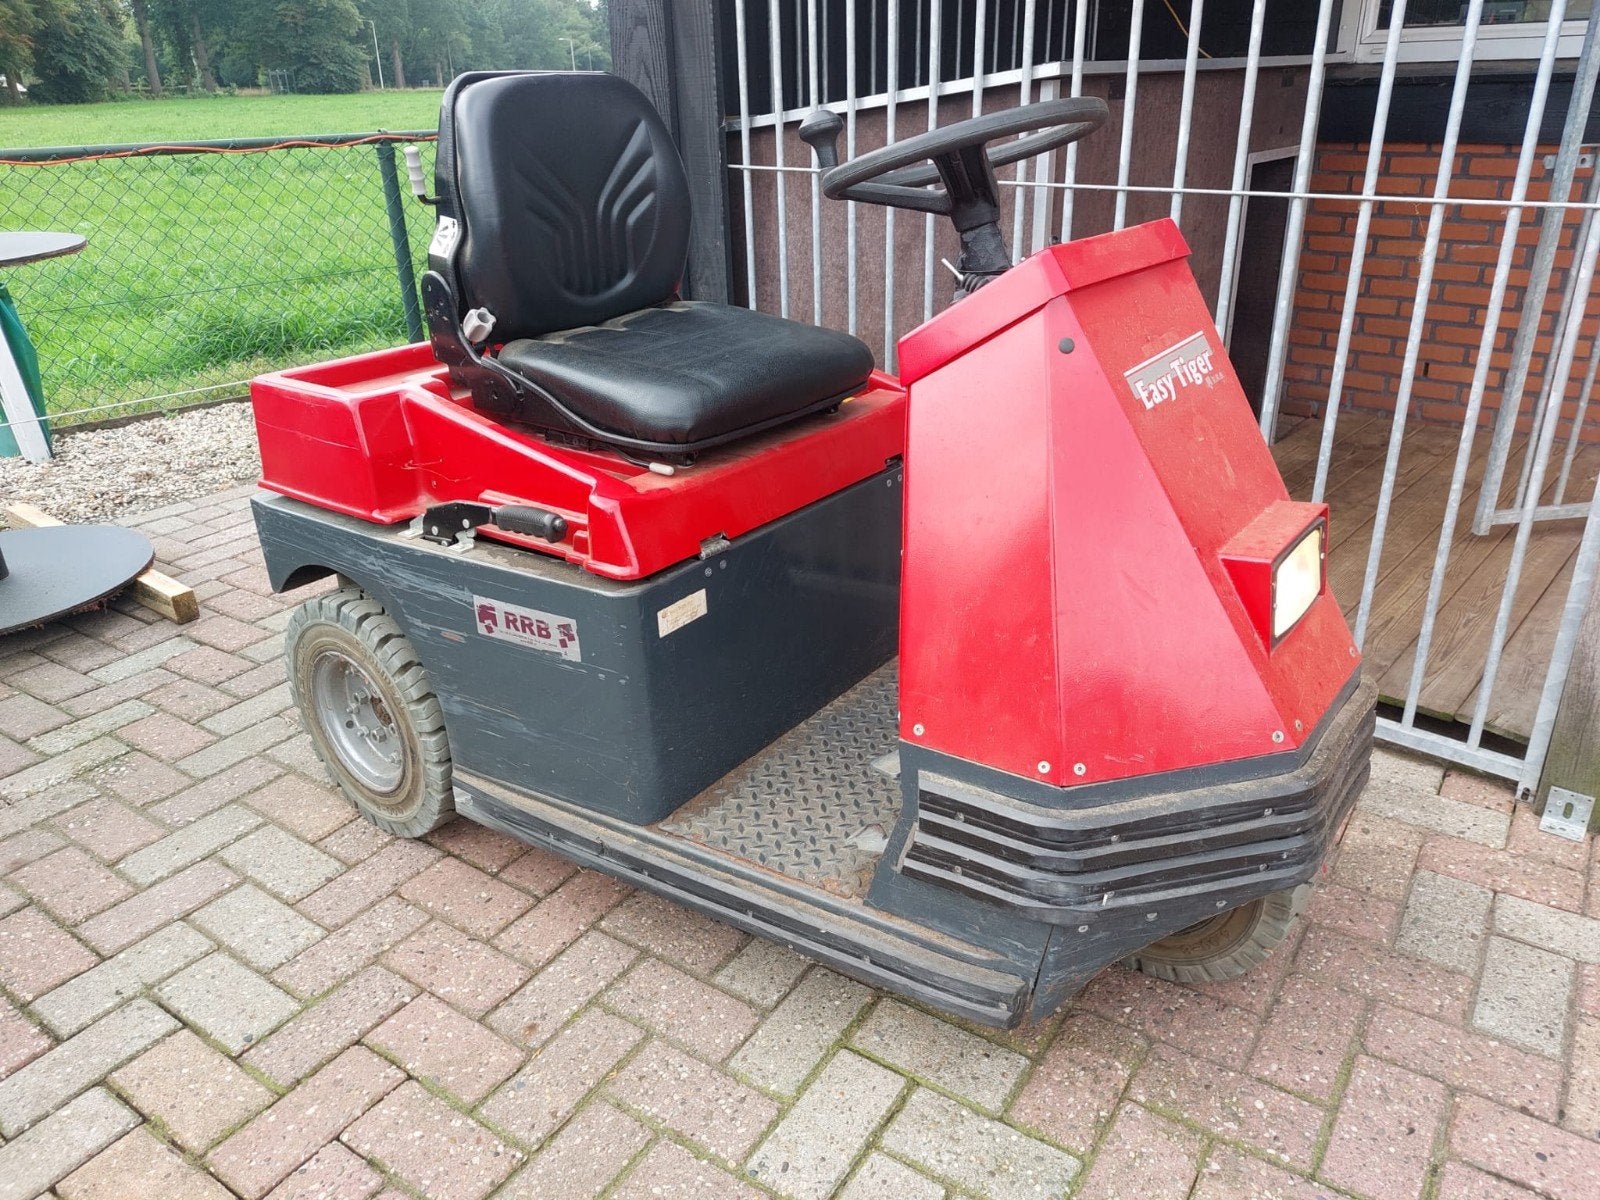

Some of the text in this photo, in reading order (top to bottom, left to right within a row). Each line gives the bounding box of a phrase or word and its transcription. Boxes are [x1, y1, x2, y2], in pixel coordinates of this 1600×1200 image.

[1135, 374, 1177, 410] Easy
[1170, 351, 1213, 387] Tiger
[504, 611, 552, 639] RRB
